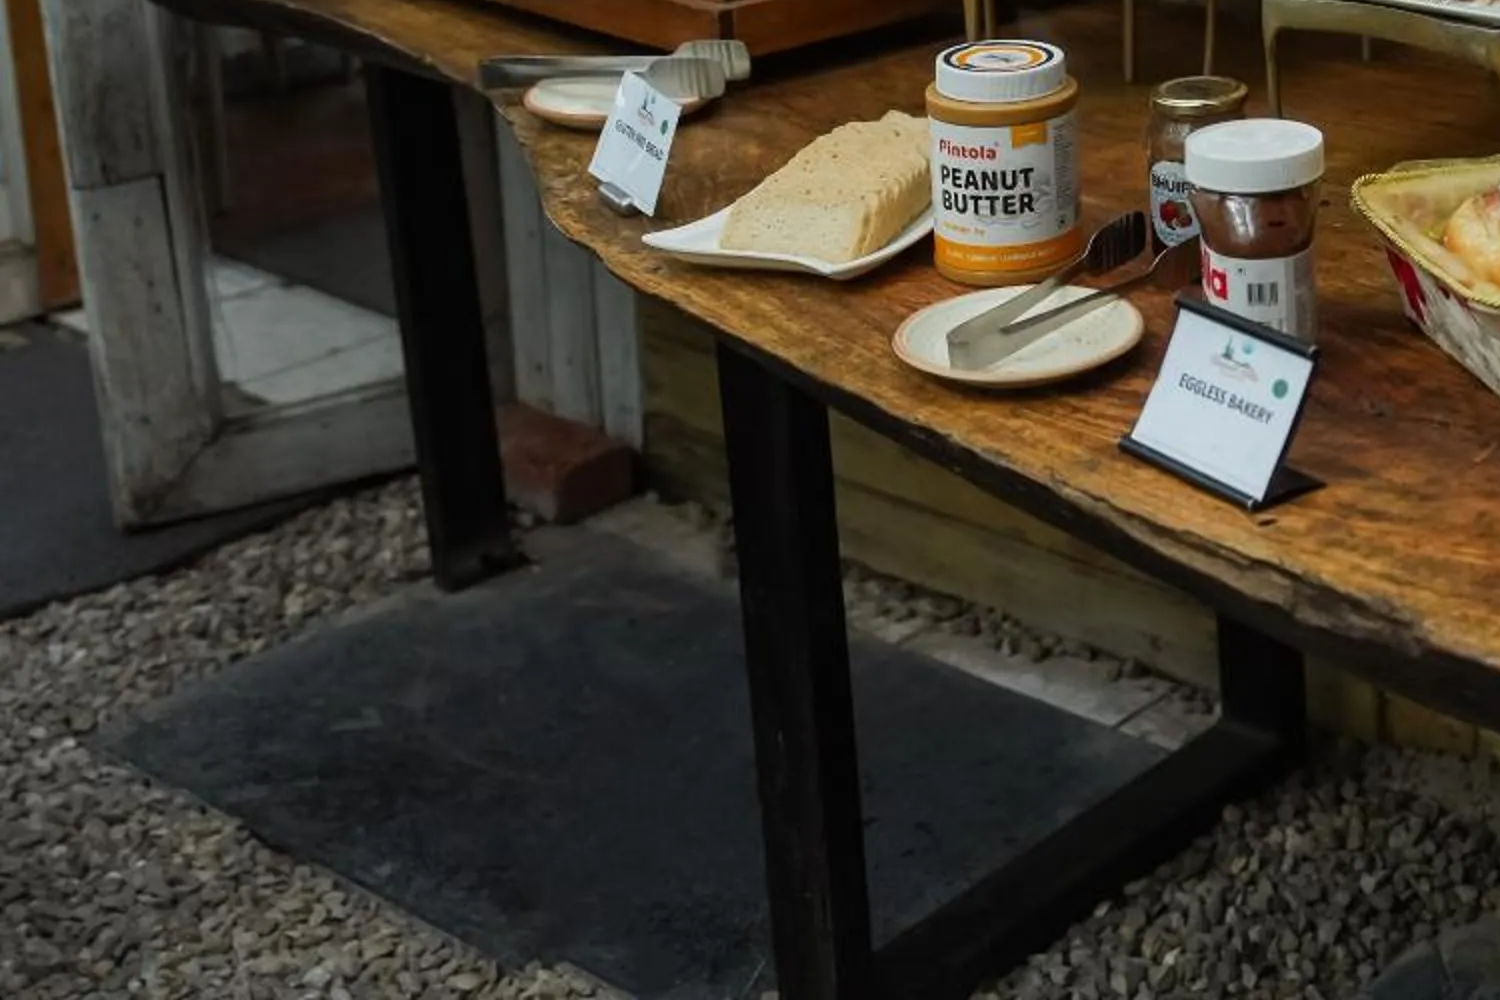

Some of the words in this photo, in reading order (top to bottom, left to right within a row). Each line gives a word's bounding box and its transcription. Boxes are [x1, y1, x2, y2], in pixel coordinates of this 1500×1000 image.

[939, 138, 997, 160] Pintola
[940, 164, 1035, 191] PEANUT
[941, 189, 1036, 217] BUTTER
[1178, 372, 1228, 405] EGGLESS
[1227, 393, 1276, 425] BAKERY
